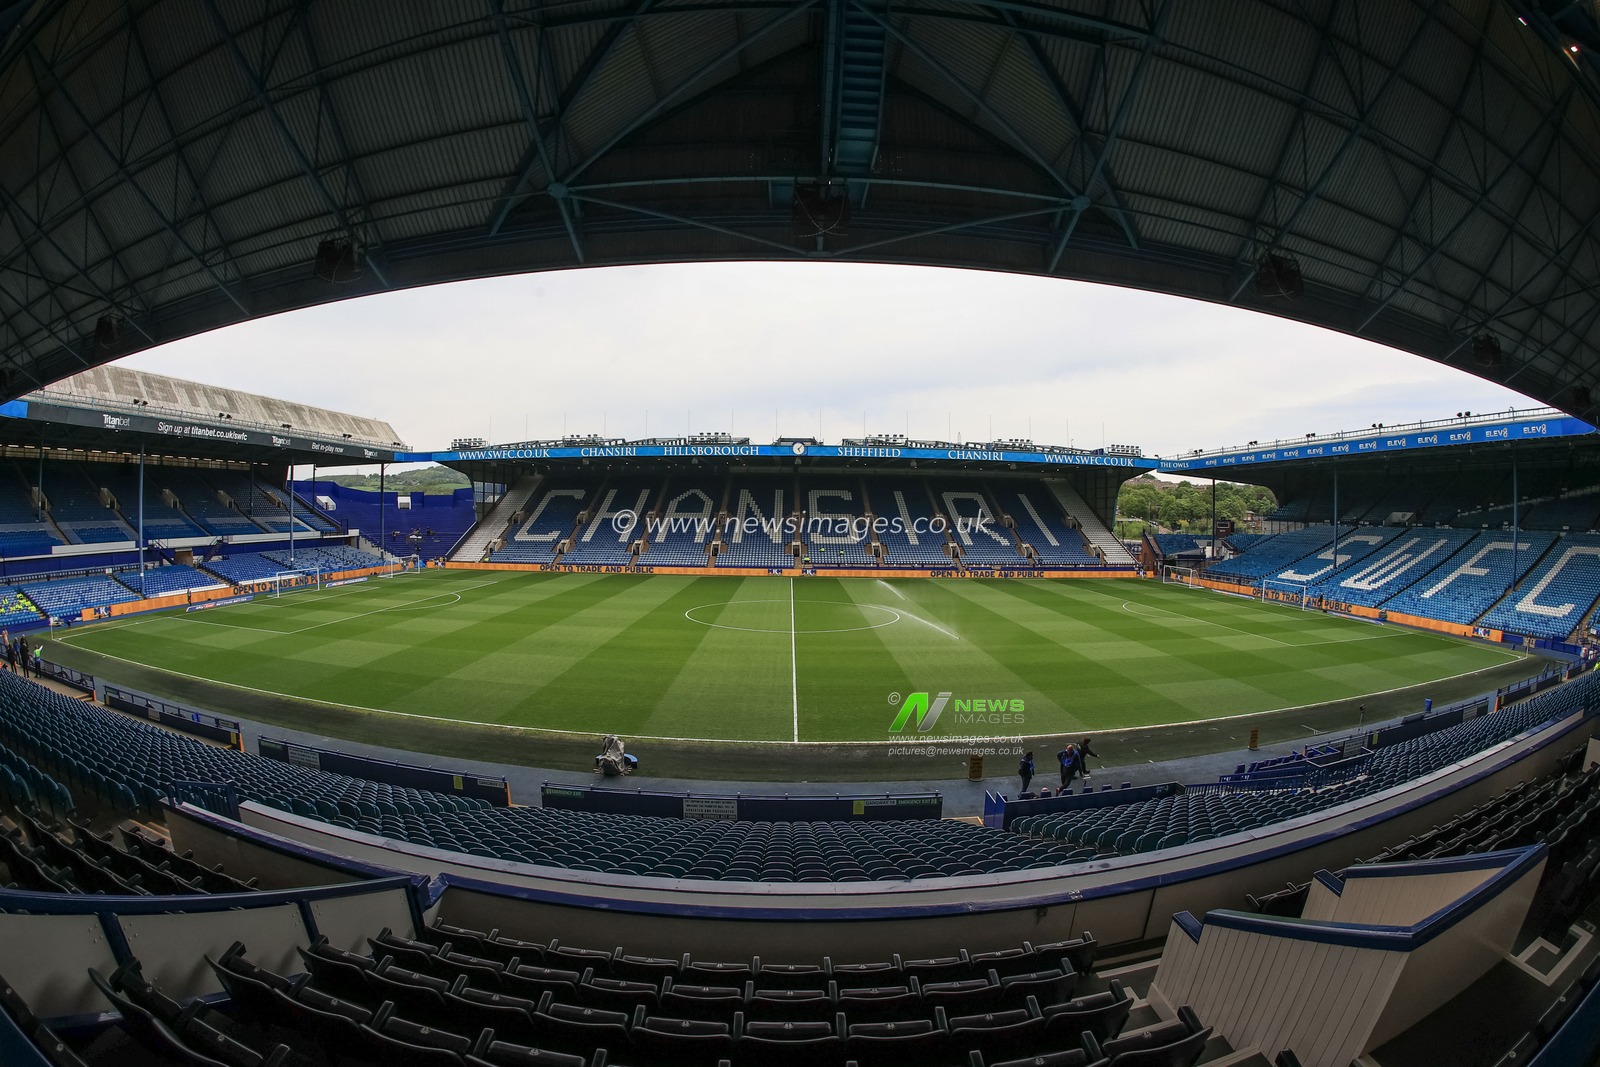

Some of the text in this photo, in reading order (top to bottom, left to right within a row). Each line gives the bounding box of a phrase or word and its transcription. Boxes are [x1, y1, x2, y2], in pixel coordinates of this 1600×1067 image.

[102, 414, 131, 427] Titanbet
[157, 421, 248, 441] Sign up at titanbet.co.uk/swfc
[1485, 427, 1508, 438] ELEV8
[1523, 423, 1547, 435] ELEV8
[1417, 434, 1438, 444] ELEV8
[1449, 431, 1471, 441] ELEV8
[311, 442, 320, 450] Bet
[320, 442, 334, 453] in-play
[1358, 441, 1377, 450] ELEV8
[1387, 438, 1406, 447] ELEV8
[458, 449, 550, 460] WWW.SWFC.CO.UK
[580, 447, 637, 457] CHANSIRI
[663, 446, 760, 456] HILLSBOROUGH
[837, 447, 901, 458] SHEFFIELD
[947, 450, 1004, 461] CHANSIRI
[1044, 454, 1134, 467] WWW.SWFC.CO.UK
[540, 564, 560, 572] OPEN
[576, 565, 602, 573] TRADE
[624, 566, 654, 574] PUBLIC
[930, 570, 952, 578] OPEN
[233, 583, 254, 596] OPEN
[256, 583, 267, 591] TO
[268, 578, 293, 589] TRADE
[294, 576, 309, 587] AND
[311, 573, 333, 585] PUBLIC
[1252, 588, 1269, 598] OPEN
[1270, 591, 1279, 599] TO
[1282, 593, 1305, 604] TRADE
[1324, 600, 1353, 613] PUBLIC
